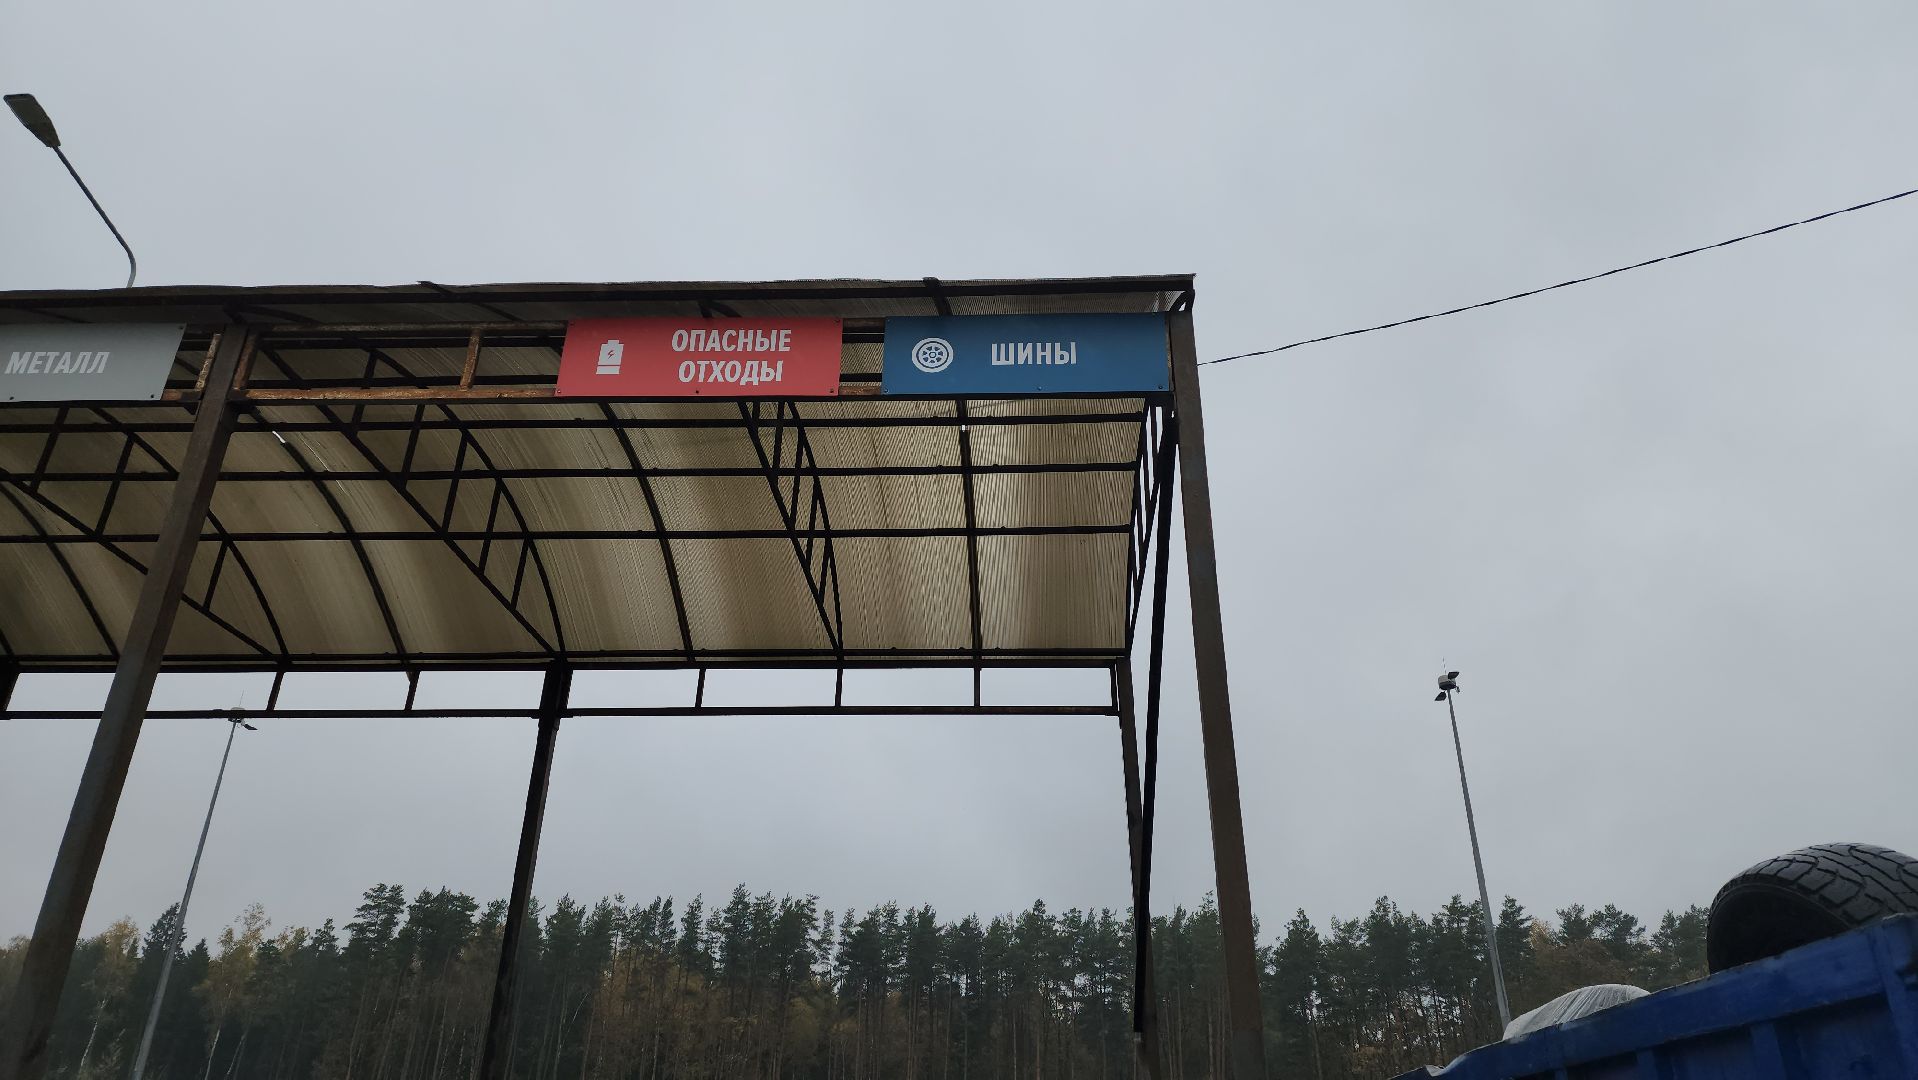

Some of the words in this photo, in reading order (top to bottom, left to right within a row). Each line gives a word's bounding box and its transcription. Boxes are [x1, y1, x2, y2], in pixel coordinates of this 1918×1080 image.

[671, 329, 791, 351] ОПАСНЫЕ
[4, 351, 110, 374] МЕТАЛЛ
[991, 342, 1077, 366] ШИНЫ
[678, 360, 783, 386] ОТХОДЫ
